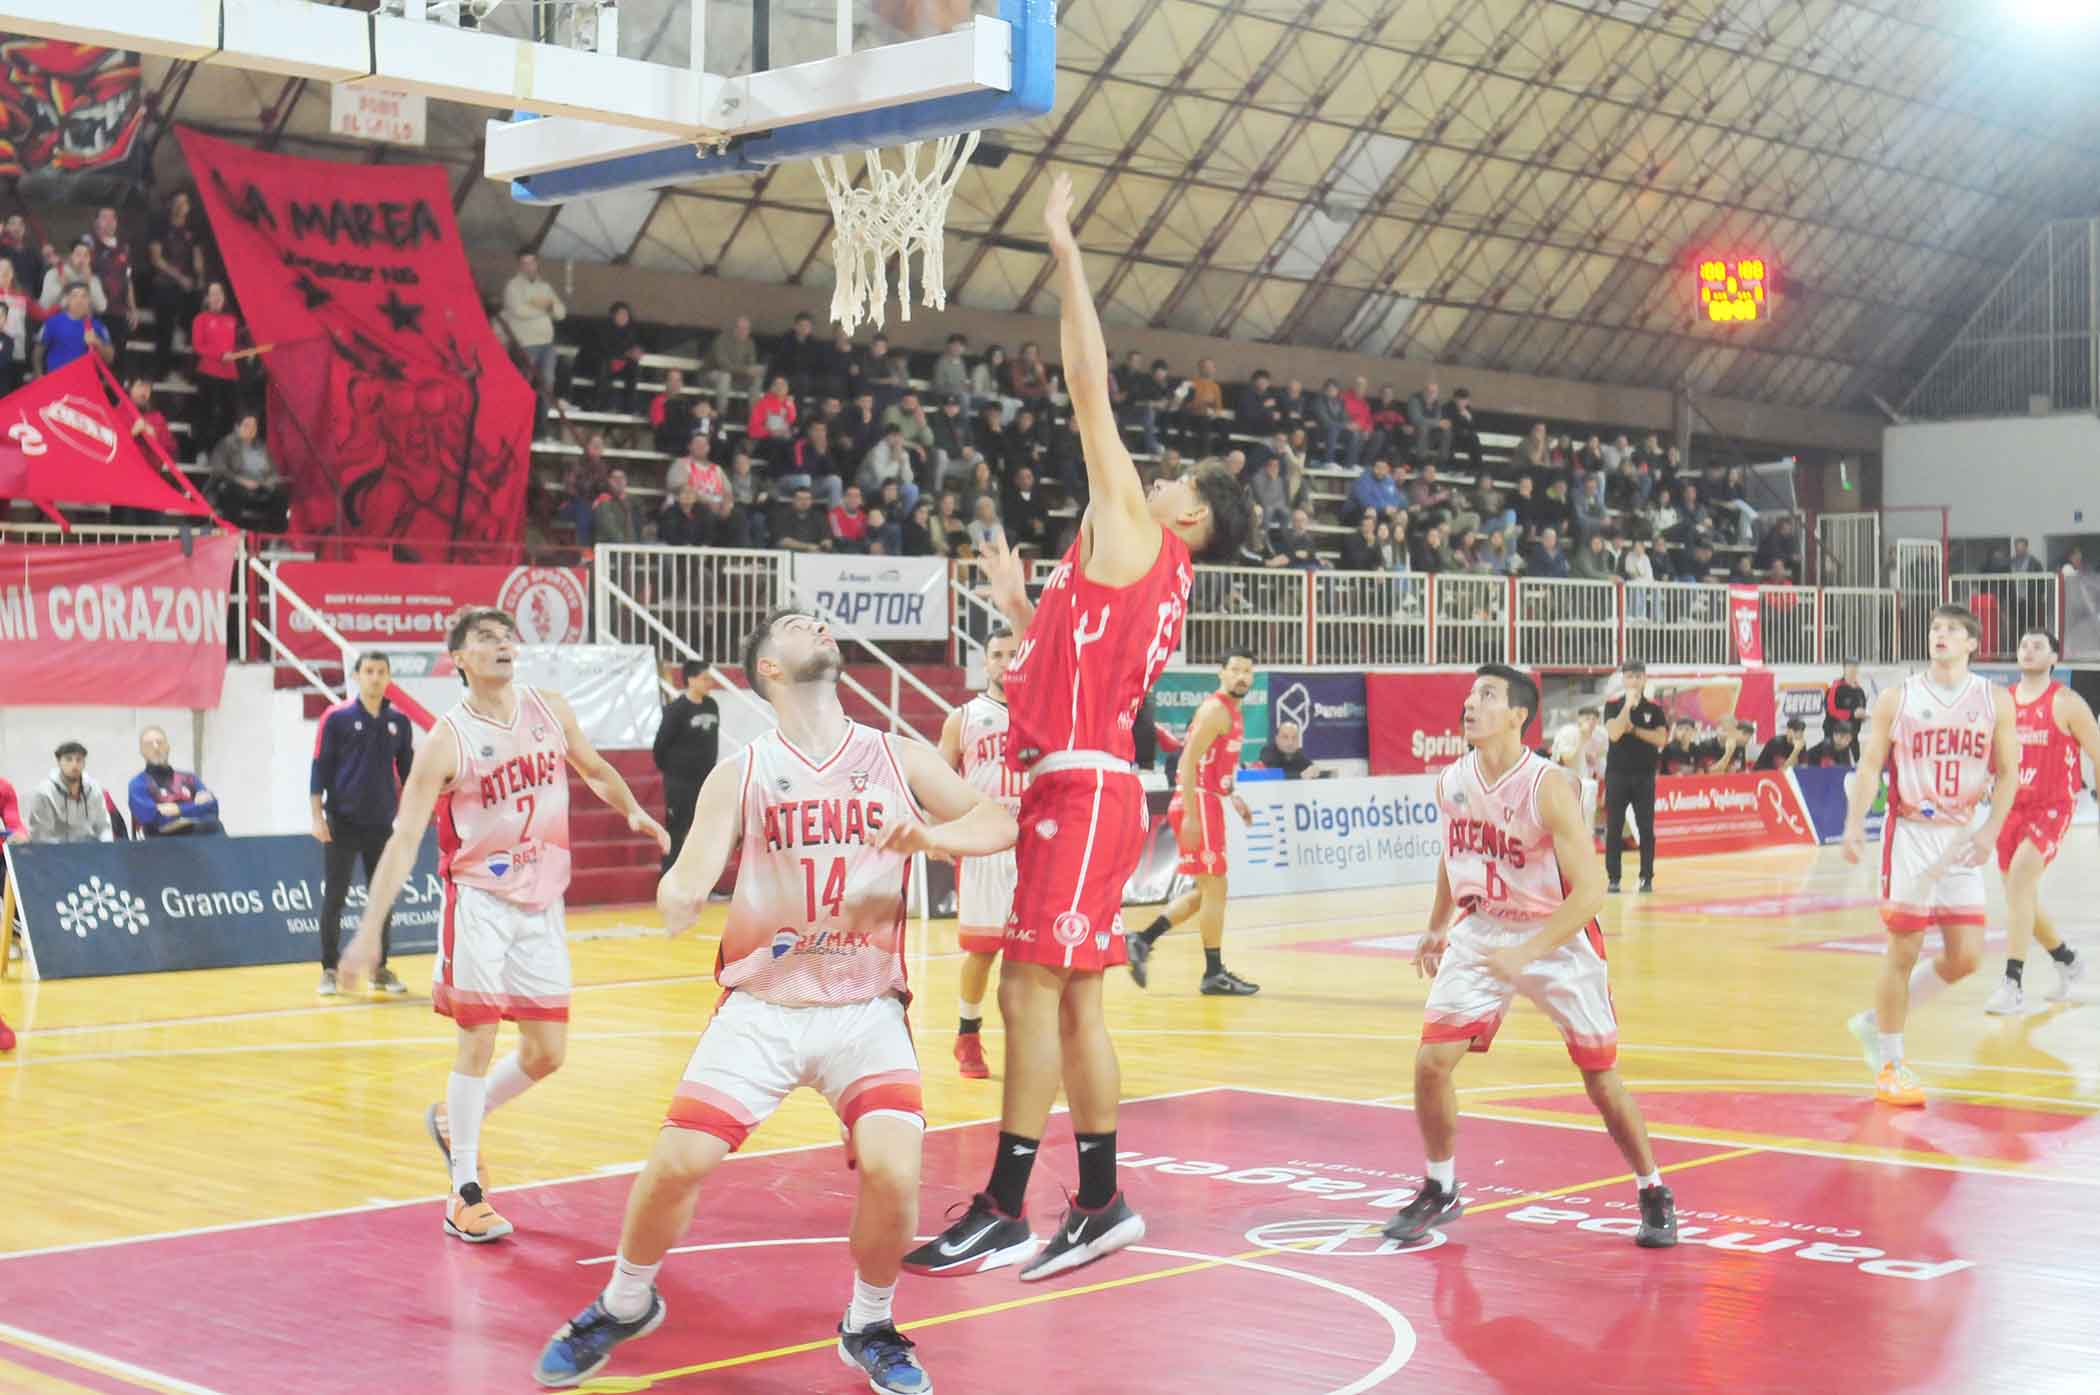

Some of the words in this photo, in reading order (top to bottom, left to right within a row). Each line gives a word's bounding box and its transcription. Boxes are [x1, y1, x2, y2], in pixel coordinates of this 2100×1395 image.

[290, 198, 442, 250] MAREA
[0, 583, 38, 640] MI
[48, 583, 228, 645] CORAZON
[816, 590, 926, 625] RAPTOR
[976, 731, 1009, 768] ATE
[1912, 727, 1985, 759] ATENAS
[1934, 760, 1961, 798] 19
[764, 798, 885, 853] ATENAS
[1294, 794, 1438, 837] Diagnóstico
[1297, 838, 1373, 870] Integral
[1376, 833, 1442, 861] Médico
[161, 886, 264, 919] Granos
[272, 879, 313, 912] del
[800, 856, 846, 923] 14
